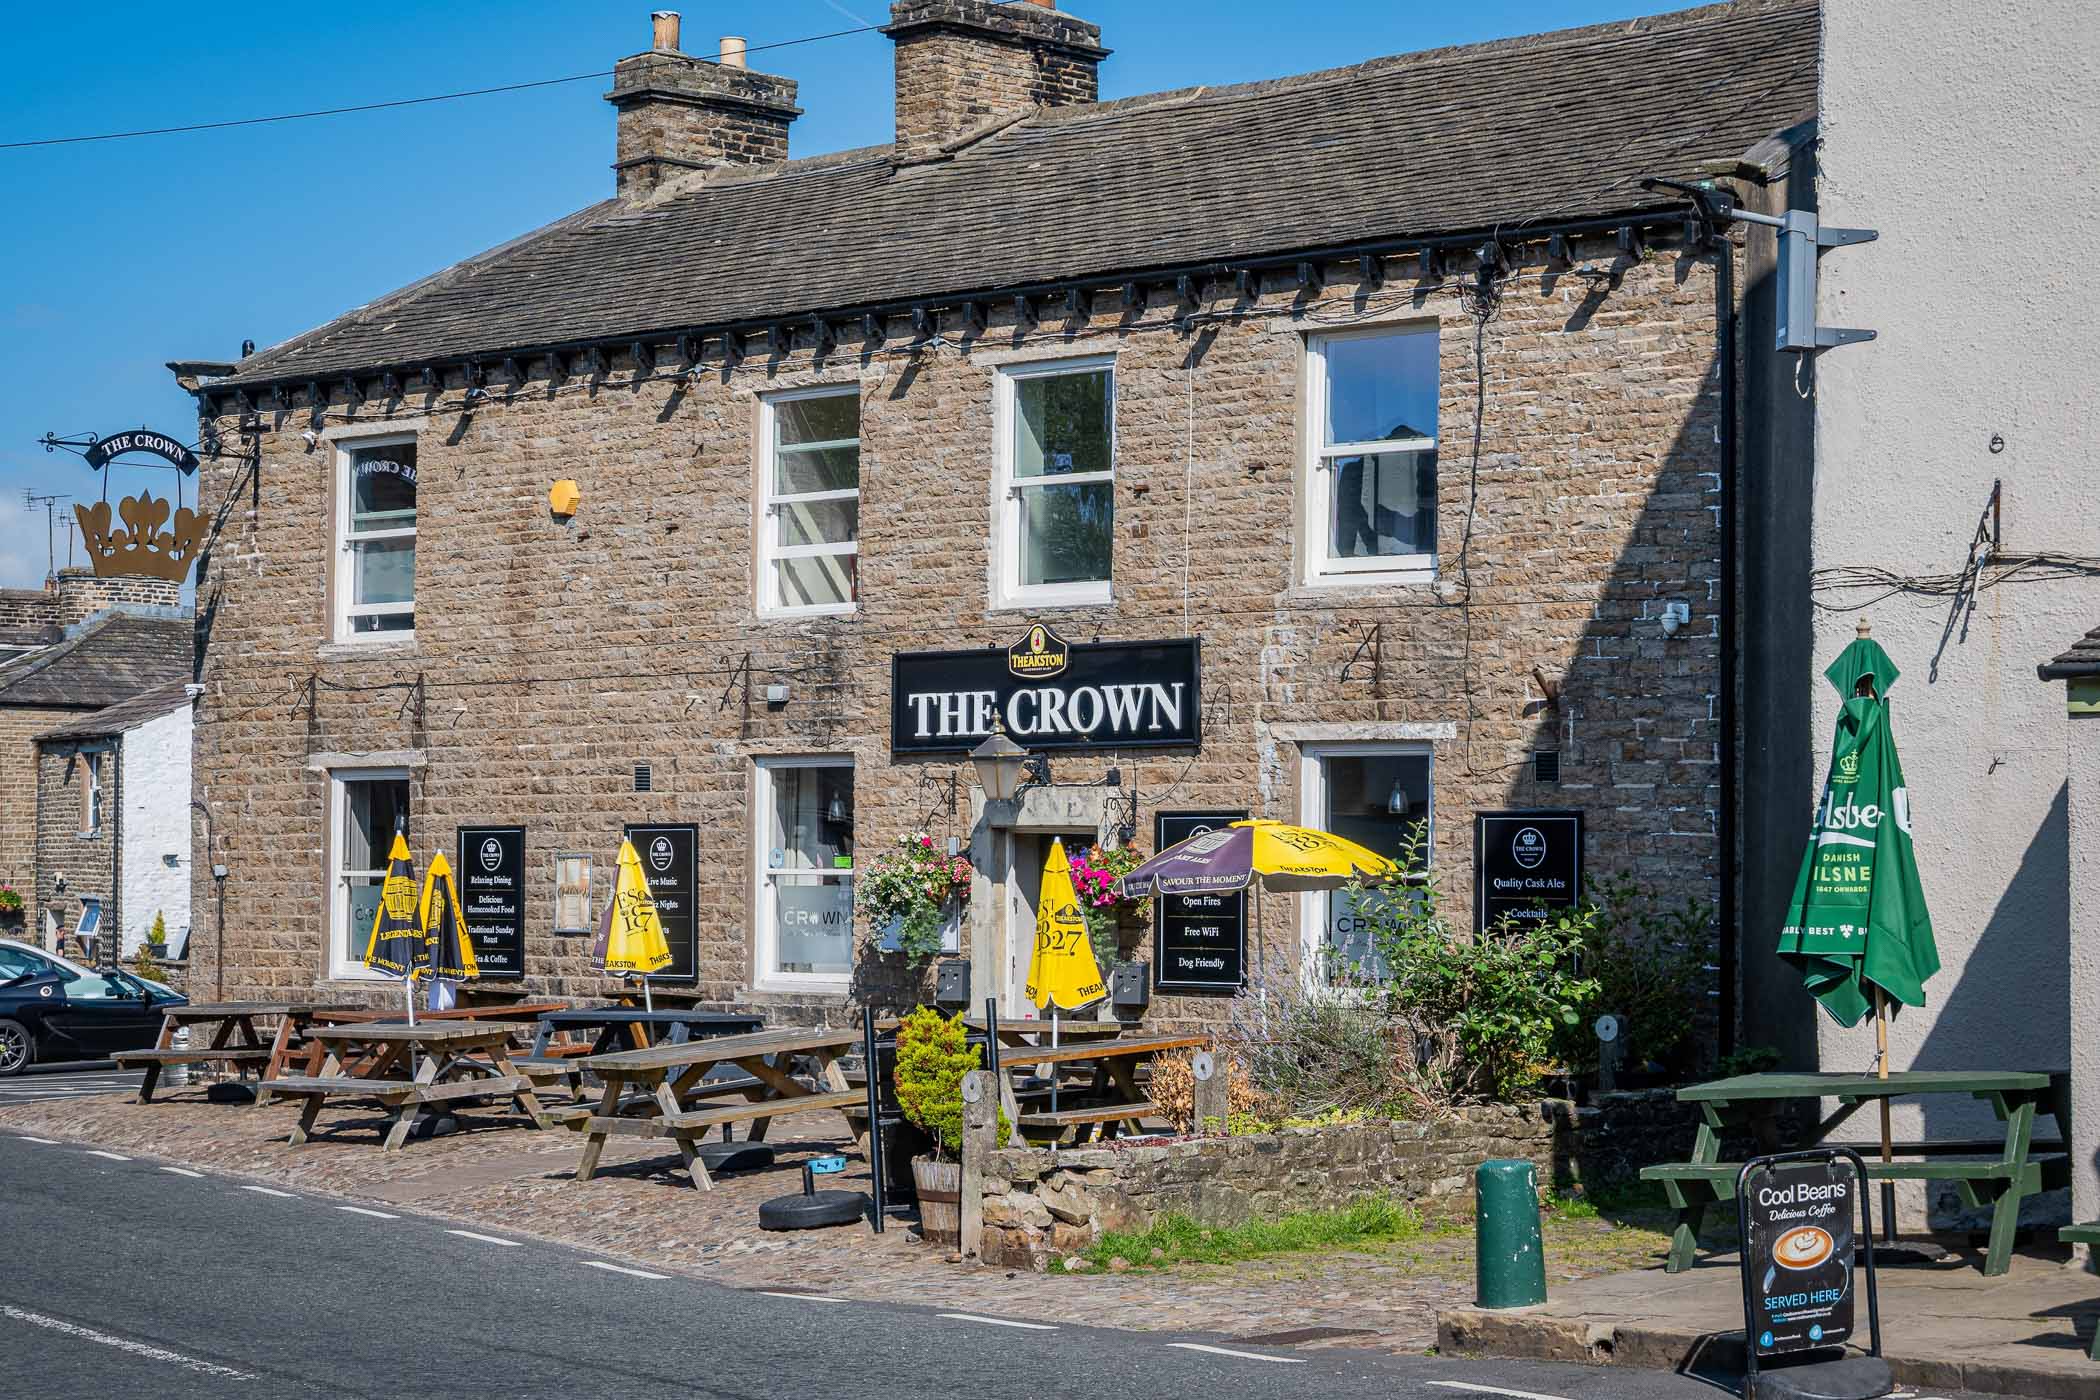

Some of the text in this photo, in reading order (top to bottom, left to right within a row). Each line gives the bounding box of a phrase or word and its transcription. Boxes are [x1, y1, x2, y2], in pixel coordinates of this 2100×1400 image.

[102, 434, 186, 461] THE CROWN
[1011, 653, 1063, 668] THEAKSTON
[908, 682, 1185, 737] THE CROWN
[1823, 853, 1860, 862] DANISH
[1814, 866, 1870, 882] ILSNE
[470, 875, 512, 886] Relaxing Dining
[646, 877, 678, 885] Live Music
[1163, 873, 1247, 887] SAVOUR THE MOMENT
[1493, 878, 1566, 890] Quality Cask Ales
[479, 895, 503, 904] Delicious
[660, 900, 679, 910] Nights
[1183, 896, 1221, 907] Open Fires
[467, 905, 515, 913] Homecooked Food
[1510, 908, 1548, 919] Cocktails
[468, 925, 515, 936] Traditional Sunday
[1184, 927, 1219, 937] Free WiFi
[1808, 927, 1835, 935] BEST
[490, 954, 508, 963] Coffee
[1178, 958, 1225, 969] Dog Friendly
[1759, 1183, 1846, 1206] Cool Beans
[1769, 1203, 1836, 1221] Delicious Coffee
[1764, 1288, 1841, 1310] SERVED HERE
